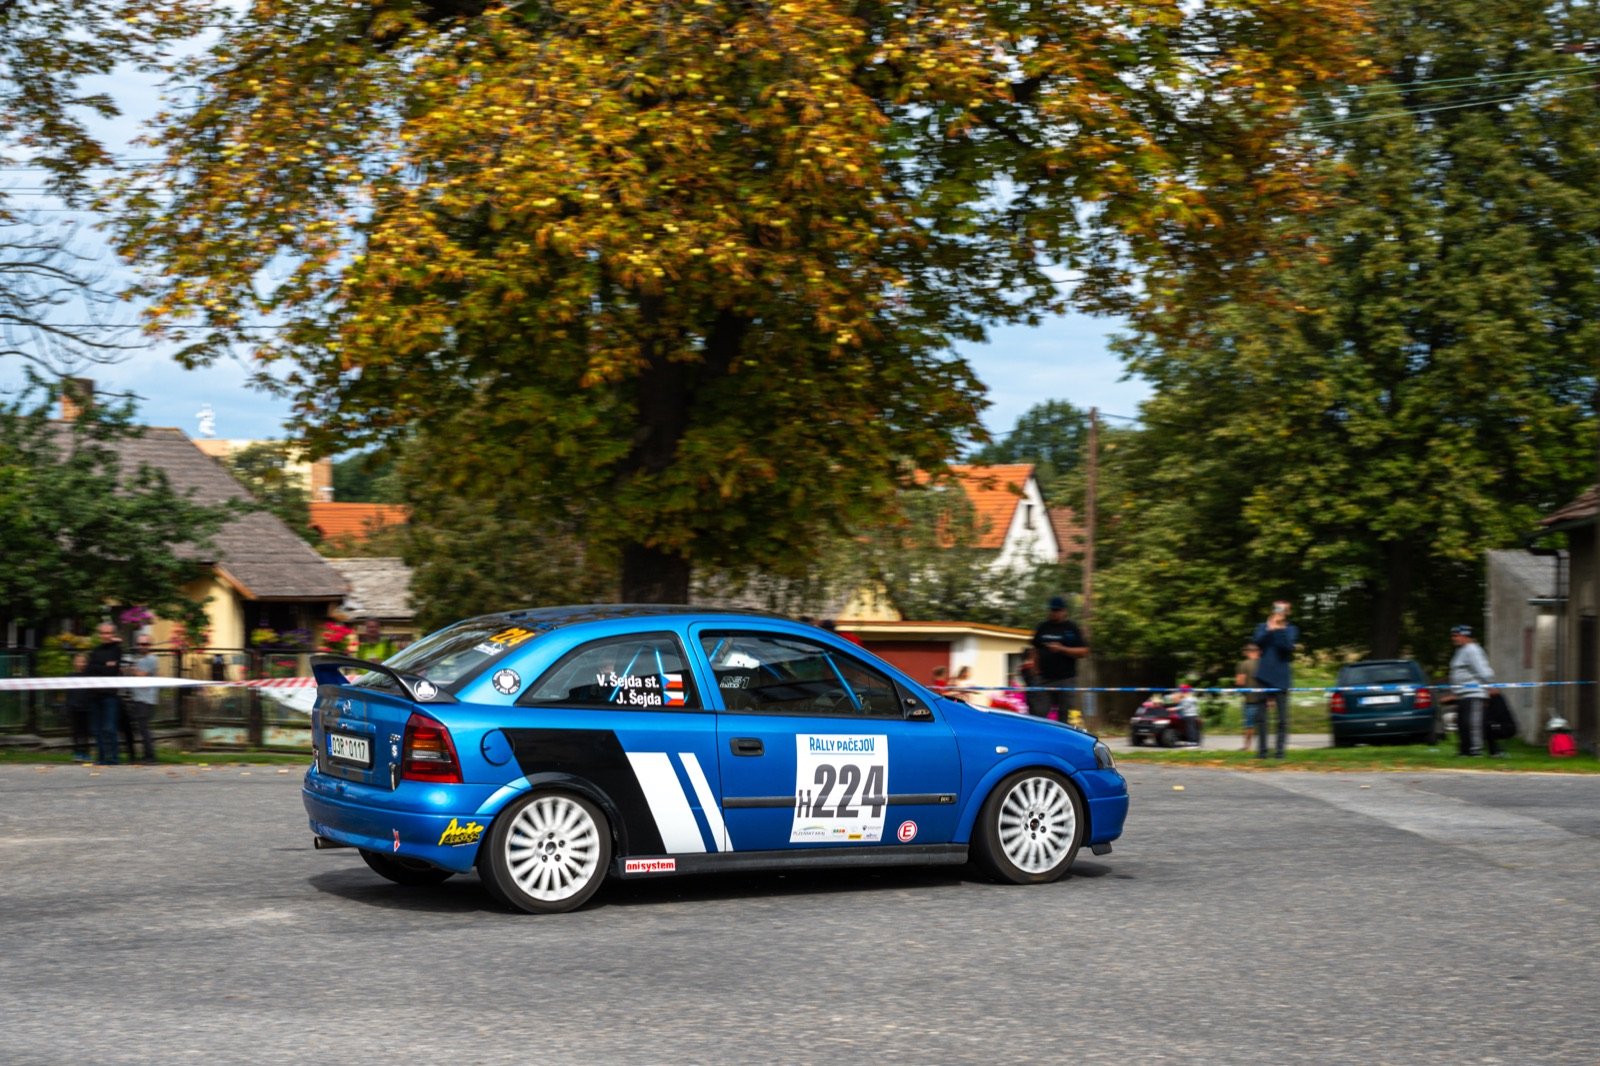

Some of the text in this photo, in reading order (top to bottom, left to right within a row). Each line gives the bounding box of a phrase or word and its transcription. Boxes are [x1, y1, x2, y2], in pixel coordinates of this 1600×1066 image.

[596, 672, 660, 690] V. Šejda st.
[616, 689, 662, 708] J. Šejda
[348, 740, 366, 760] 0117
[809, 736, 875, 752] RALLY PAČEJOV
[812, 764, 886, 818] 224
[438, 817, 485, 847] Auto
